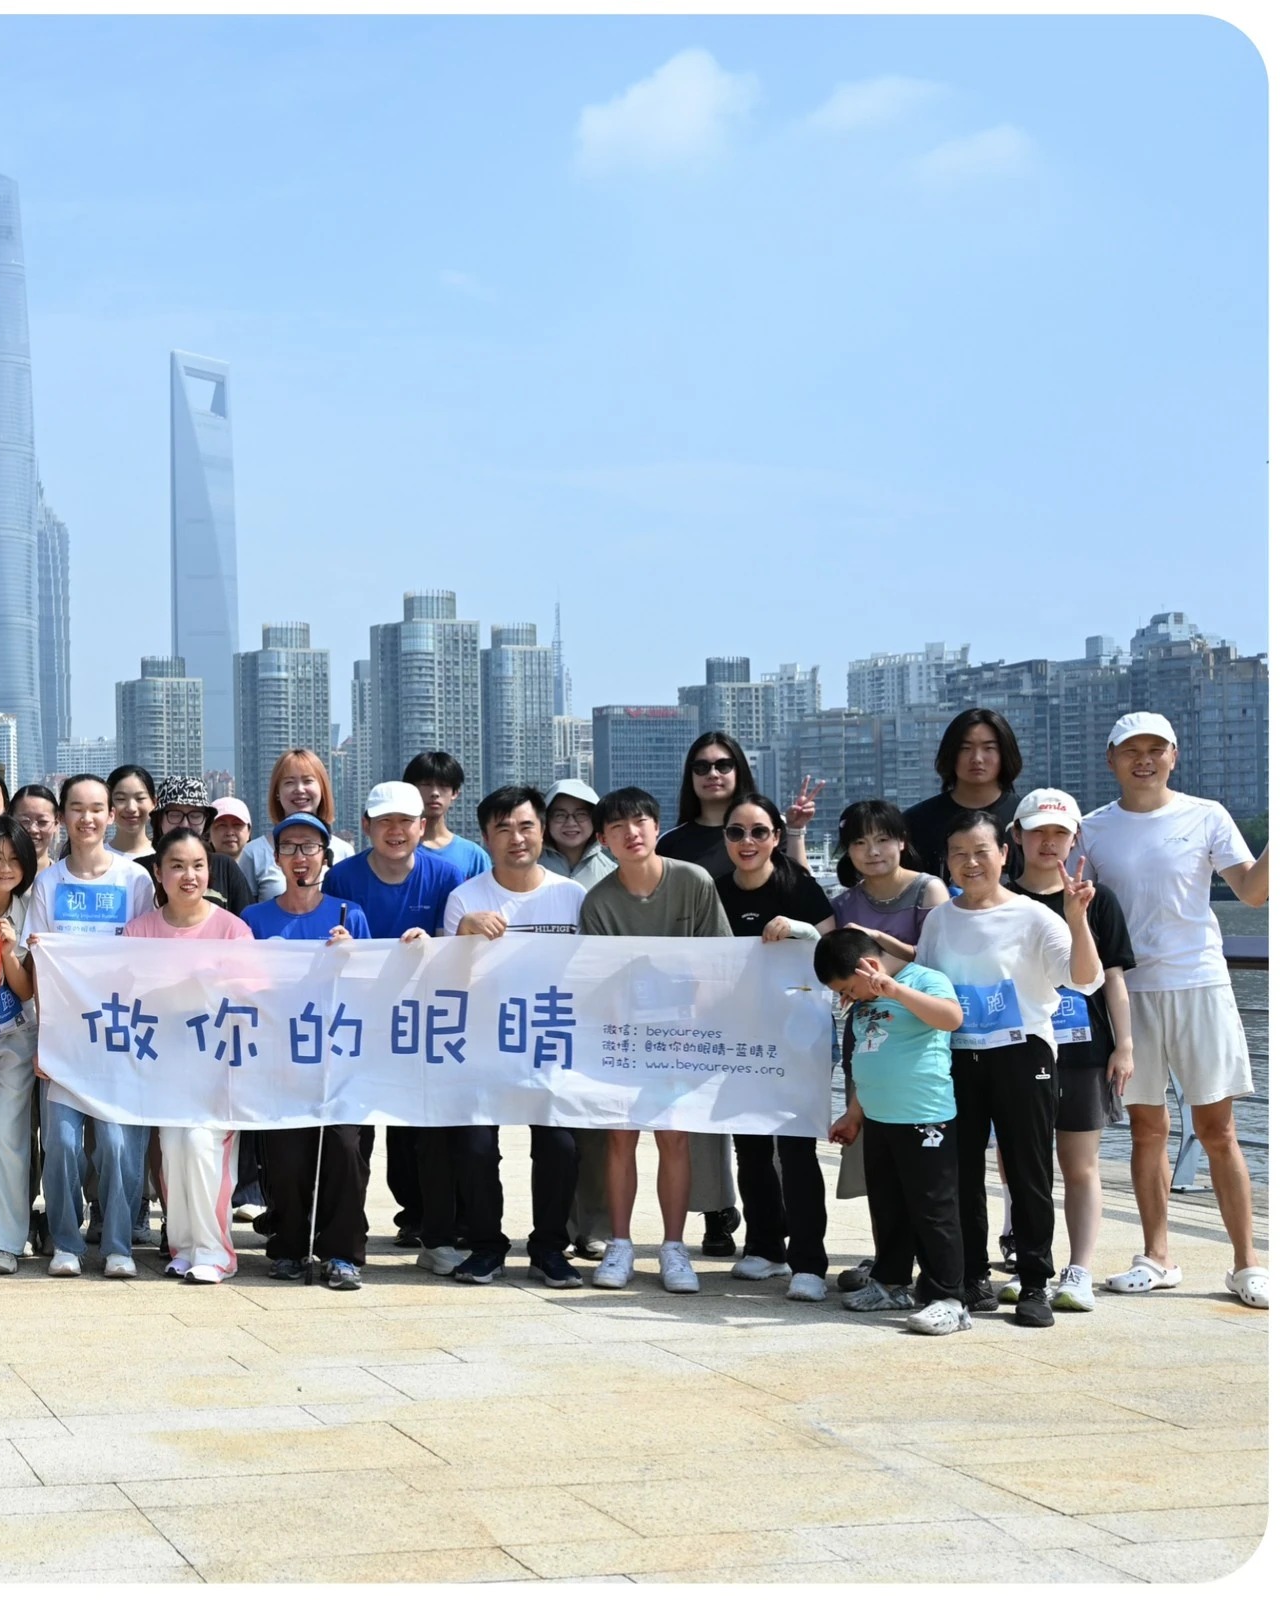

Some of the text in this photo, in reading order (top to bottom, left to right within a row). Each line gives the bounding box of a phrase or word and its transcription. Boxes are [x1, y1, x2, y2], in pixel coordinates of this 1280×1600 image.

[67, 891, 115, 912] 视障
[81, 984, 577, 1070] 做你的眼睛
[646, 1025, 722, 1039] beyoureyes
[645, 1059, 786, 1077] www.beyoureyes.org
